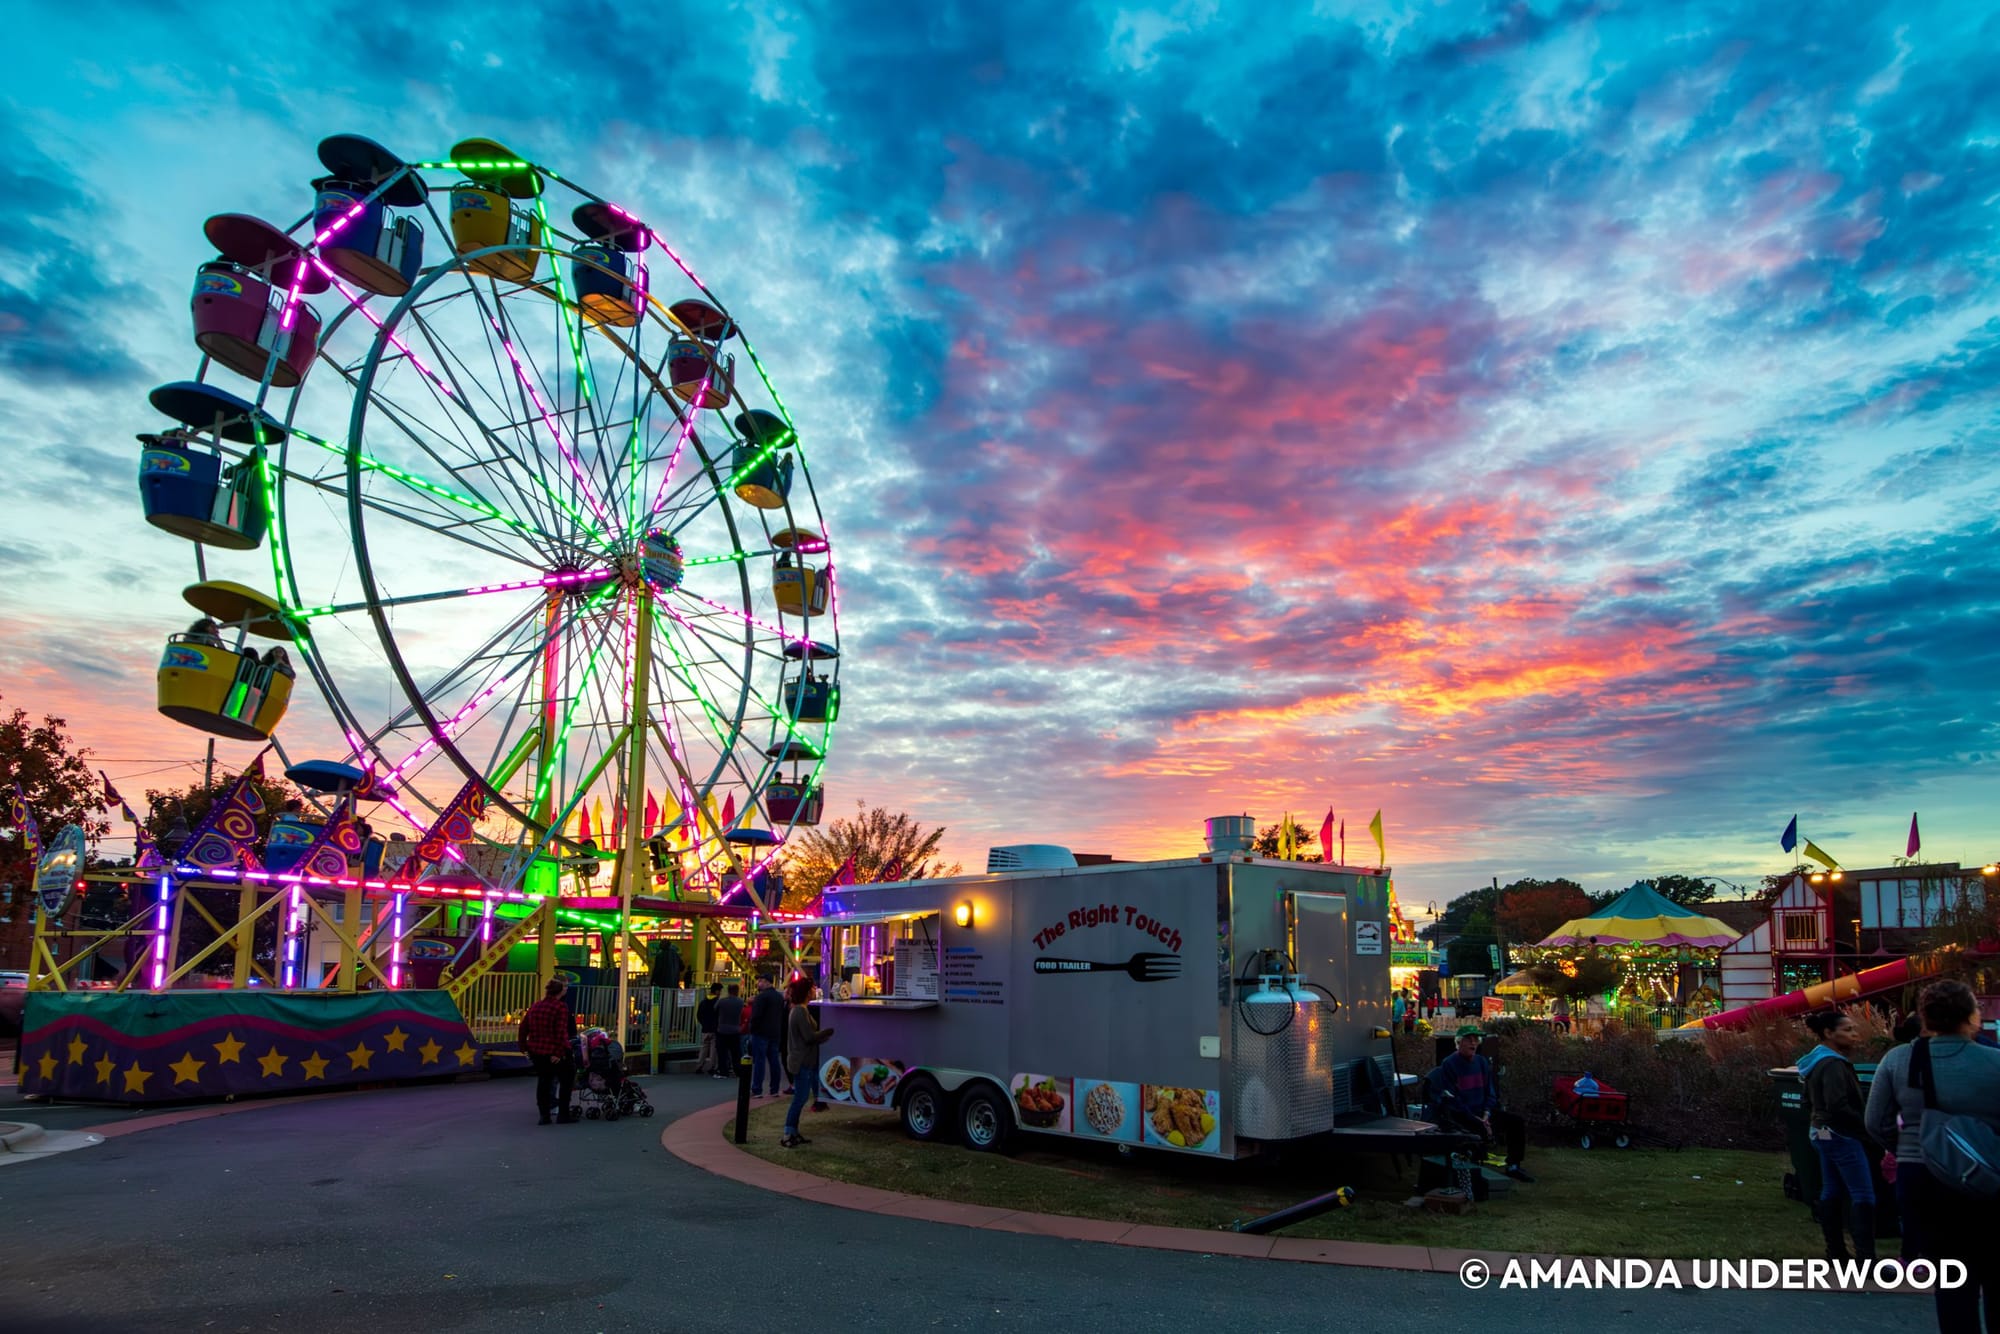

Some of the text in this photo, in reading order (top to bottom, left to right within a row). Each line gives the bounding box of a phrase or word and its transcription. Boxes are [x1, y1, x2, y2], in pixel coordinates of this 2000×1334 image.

[1033, 904, 1183, 952] The Right Touch
[1036, 961, 1091, 970] FOOD TRAILER
